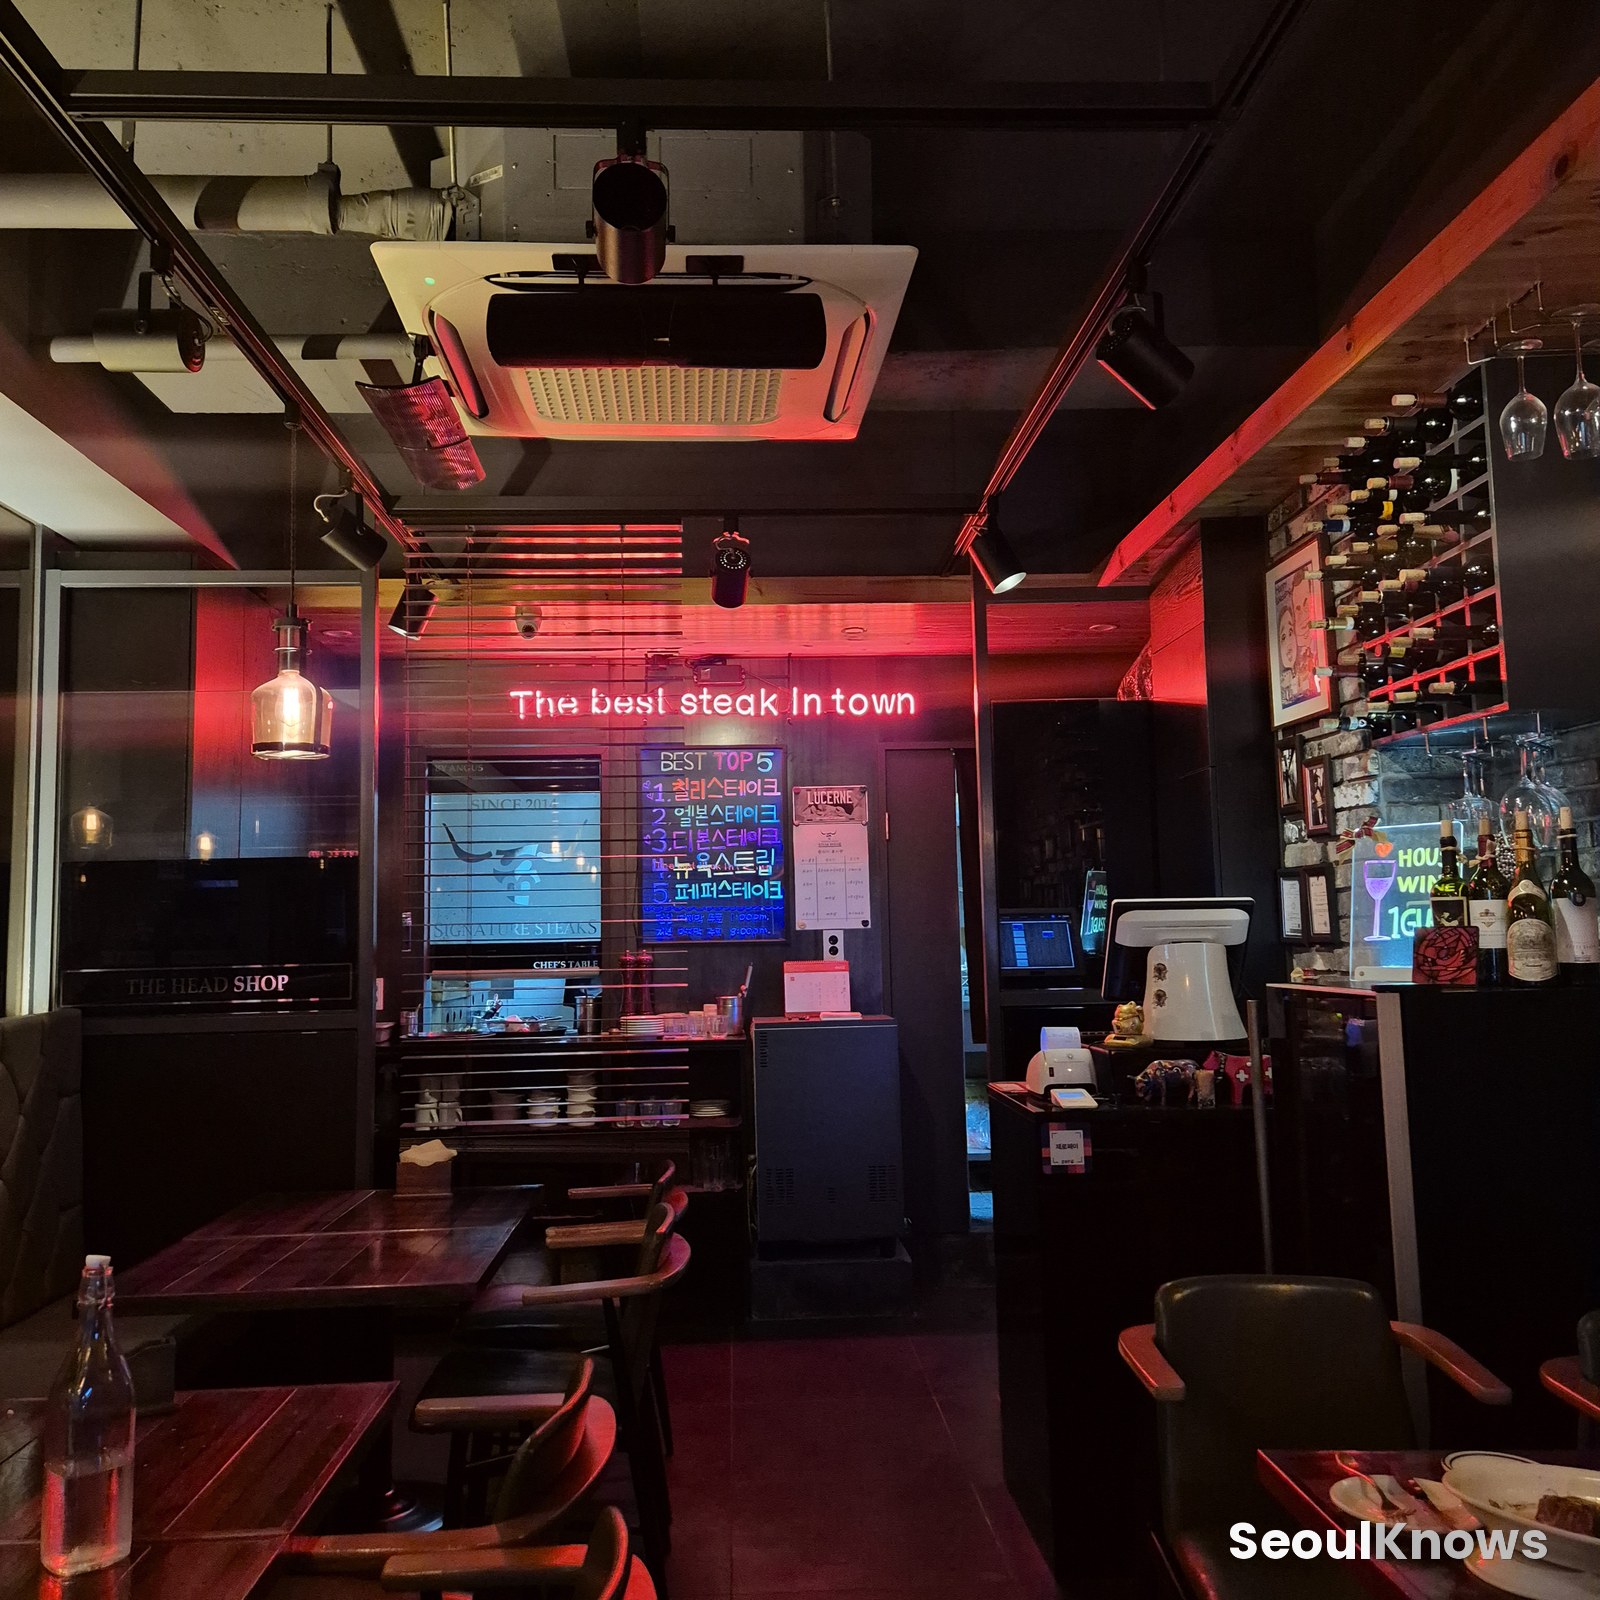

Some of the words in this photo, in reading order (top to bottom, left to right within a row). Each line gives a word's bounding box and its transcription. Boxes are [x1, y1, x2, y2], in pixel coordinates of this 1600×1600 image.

[510, 690, 579, 720] The
[680, 687, 779, 715] steak
[831, 687, 915, 715] town
[661, 751, 707, 771] BEST
[713, 751, 754, 771] TOP
[756, 751, 775, 773] 5
[471, 798, 522, 810] SINCE
[806, 790, 854, 806] LUCERNE
[674, 880, 783, 901] 페퍼스테이크
[535, 921, 597, 935] STEAKS
[533, 960, 567, 969] CHEF'S
[567, 960, 599, 968] TABLE
[126, 978, 167, 995] THE
[171, 977, 229, 994] HEAD
[233, 974, 290, 993] SHOP
